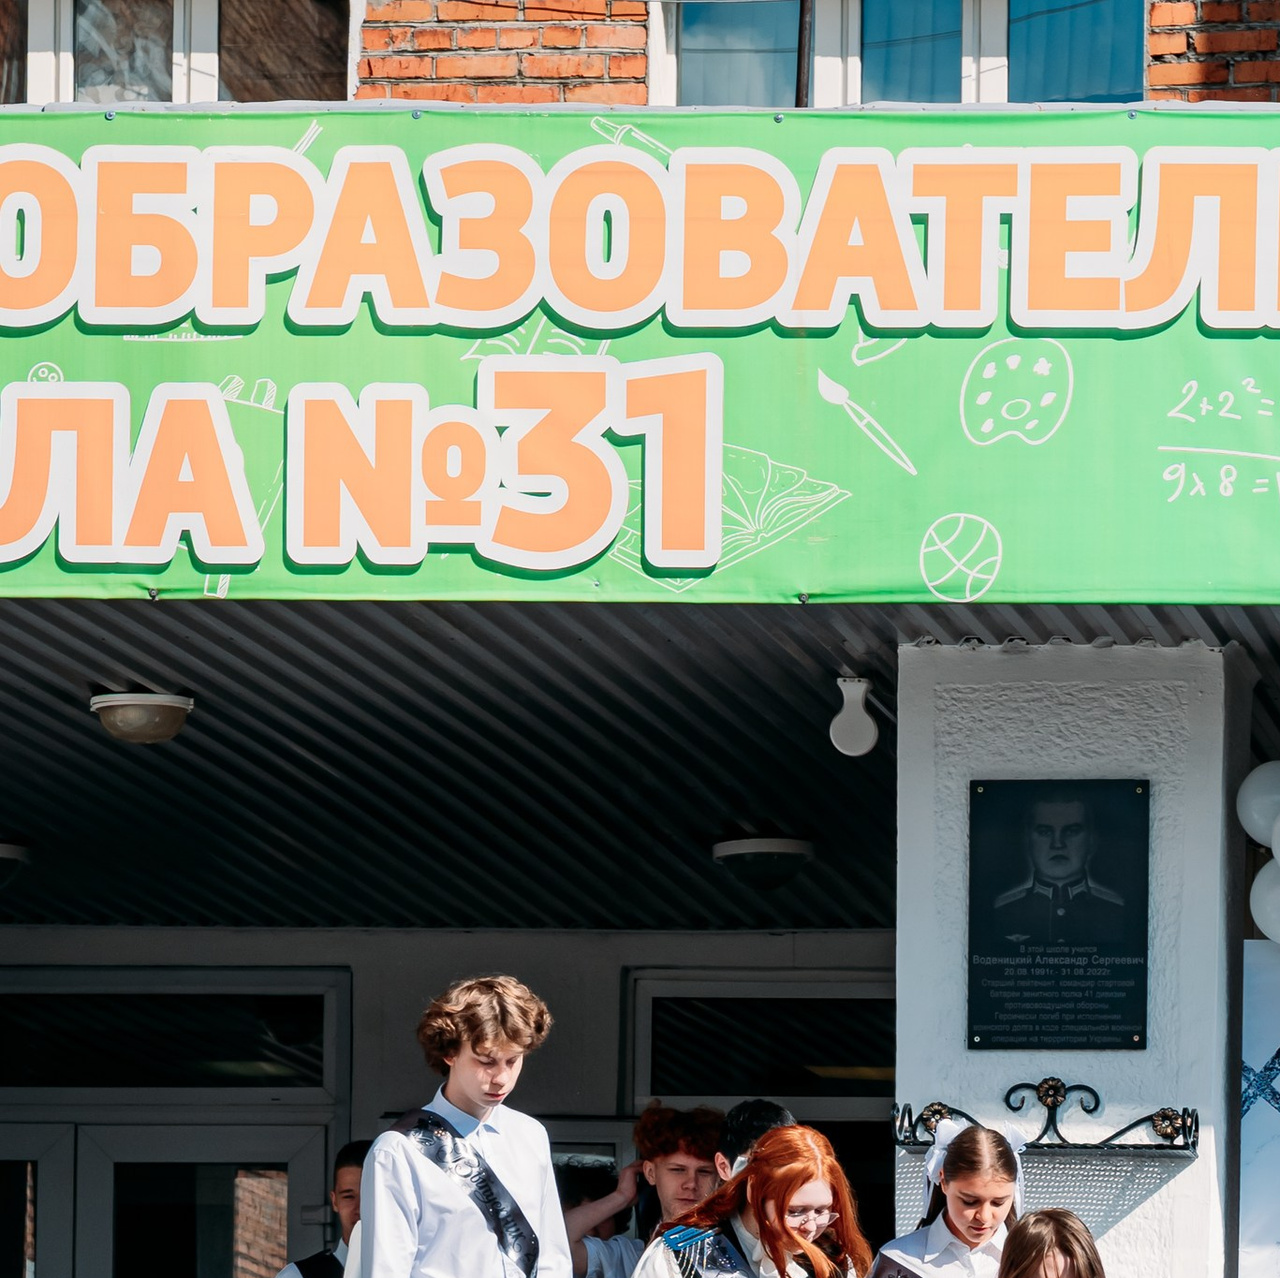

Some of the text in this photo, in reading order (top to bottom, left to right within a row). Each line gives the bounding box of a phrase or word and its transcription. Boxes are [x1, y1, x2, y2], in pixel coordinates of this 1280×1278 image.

[294, 360, 715, 561] №31
[1034, 954, 1089, 966] Александр
[1091, 954, 1144, 966] Сергеевич
